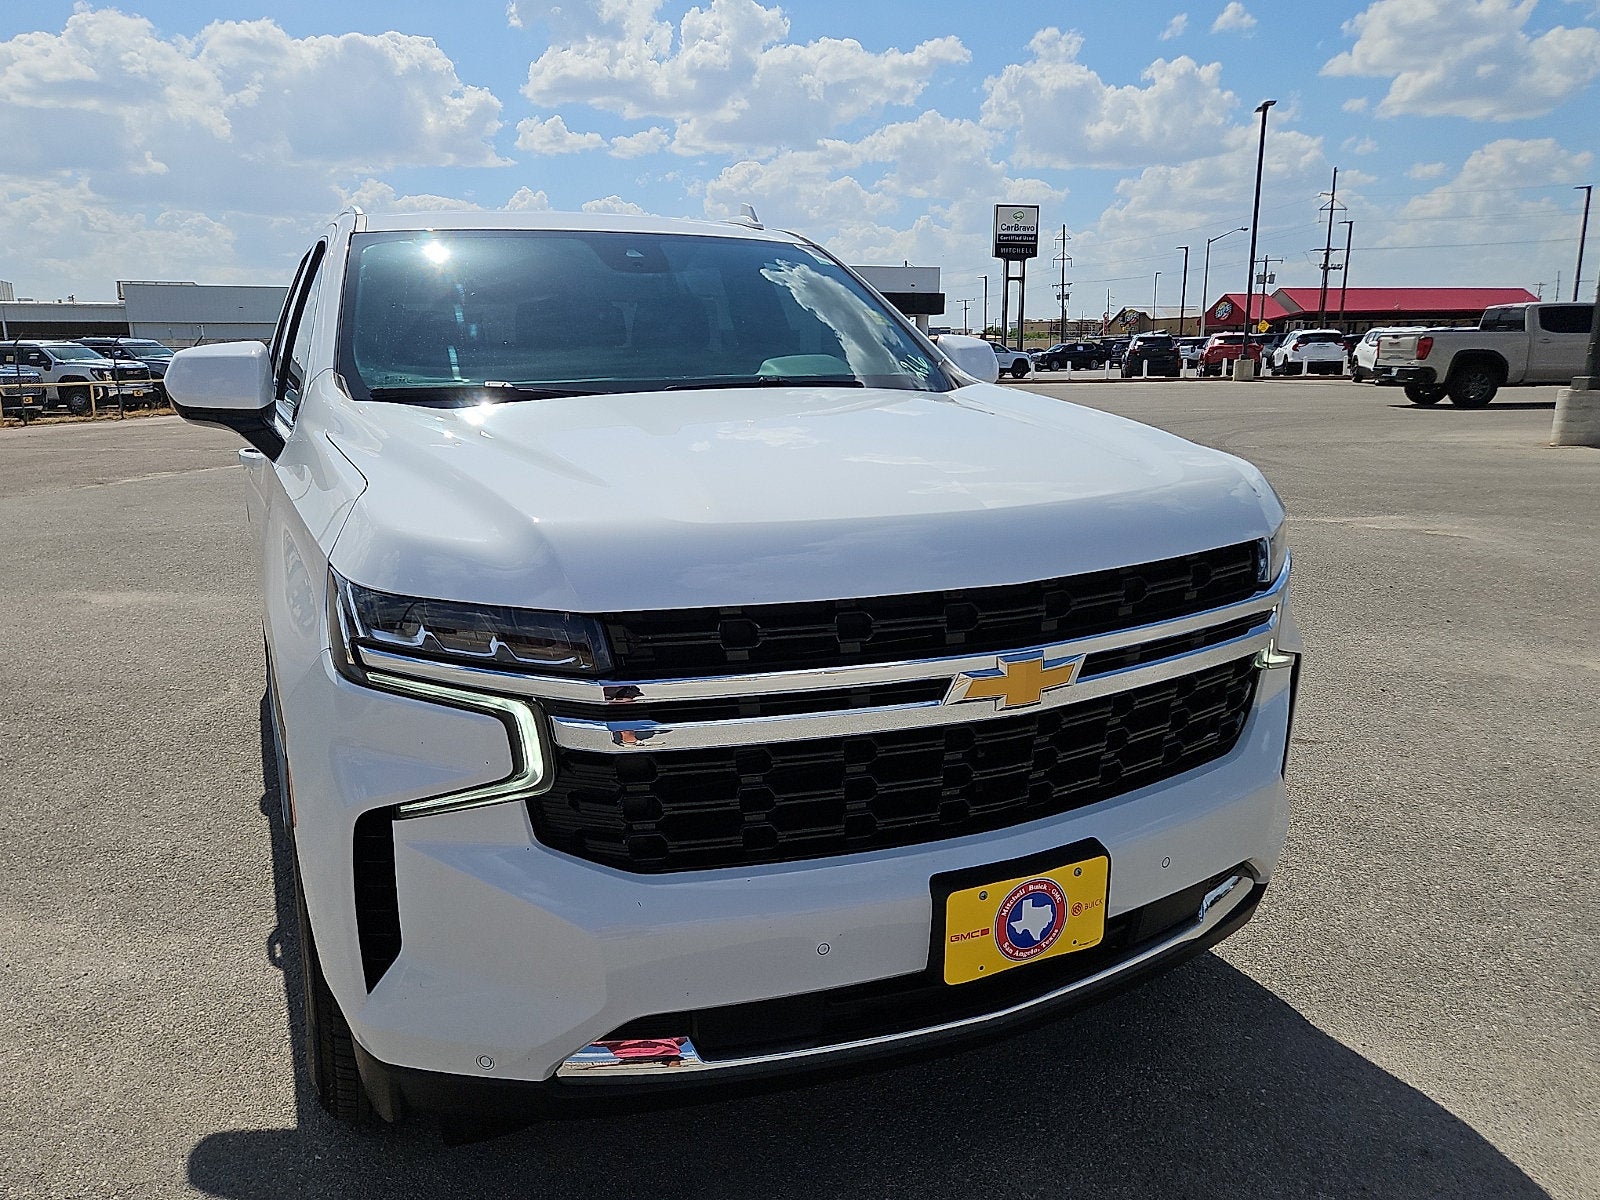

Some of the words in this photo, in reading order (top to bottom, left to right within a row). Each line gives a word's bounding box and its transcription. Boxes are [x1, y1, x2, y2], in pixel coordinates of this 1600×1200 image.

[1000, 223, 1035, 232] CarBravo
[1001, 888, 1026, 917] Mitchell
[1029, 883, 1048, 892] Buick
[1051, 888, 1062, 904] GMC
[1084, 898, 1103, 911] BUICK
[950, 930, 980, 943] GMC
[1002, 941, 1013, 957] San
[1042, 928, 1059, 949] Texas
